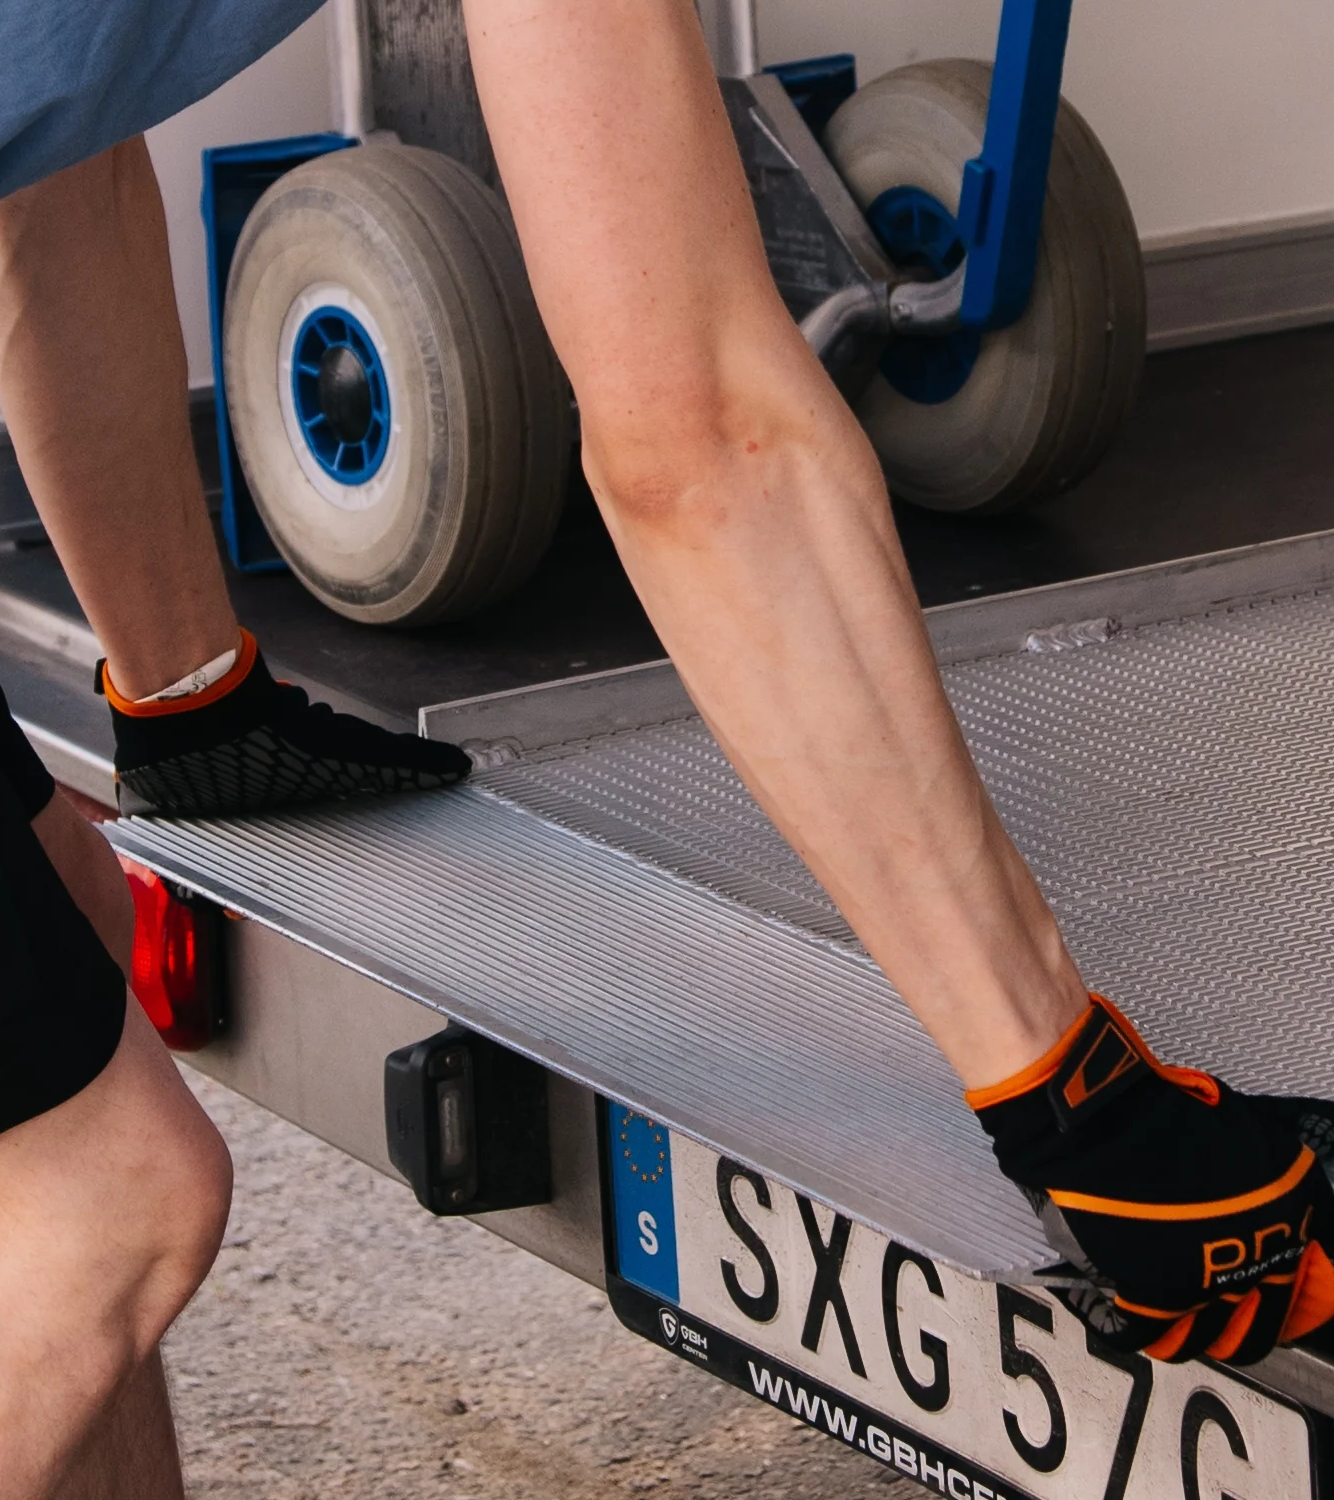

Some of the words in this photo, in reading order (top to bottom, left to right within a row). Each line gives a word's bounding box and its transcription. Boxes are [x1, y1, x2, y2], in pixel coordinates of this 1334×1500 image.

[638, 1210, 659, 1257] S
[715, 1156, 951, 1413] SXG
[680, 1325, 708, 1350] GBH
[682, 1343, 708, 1362] CENTER
